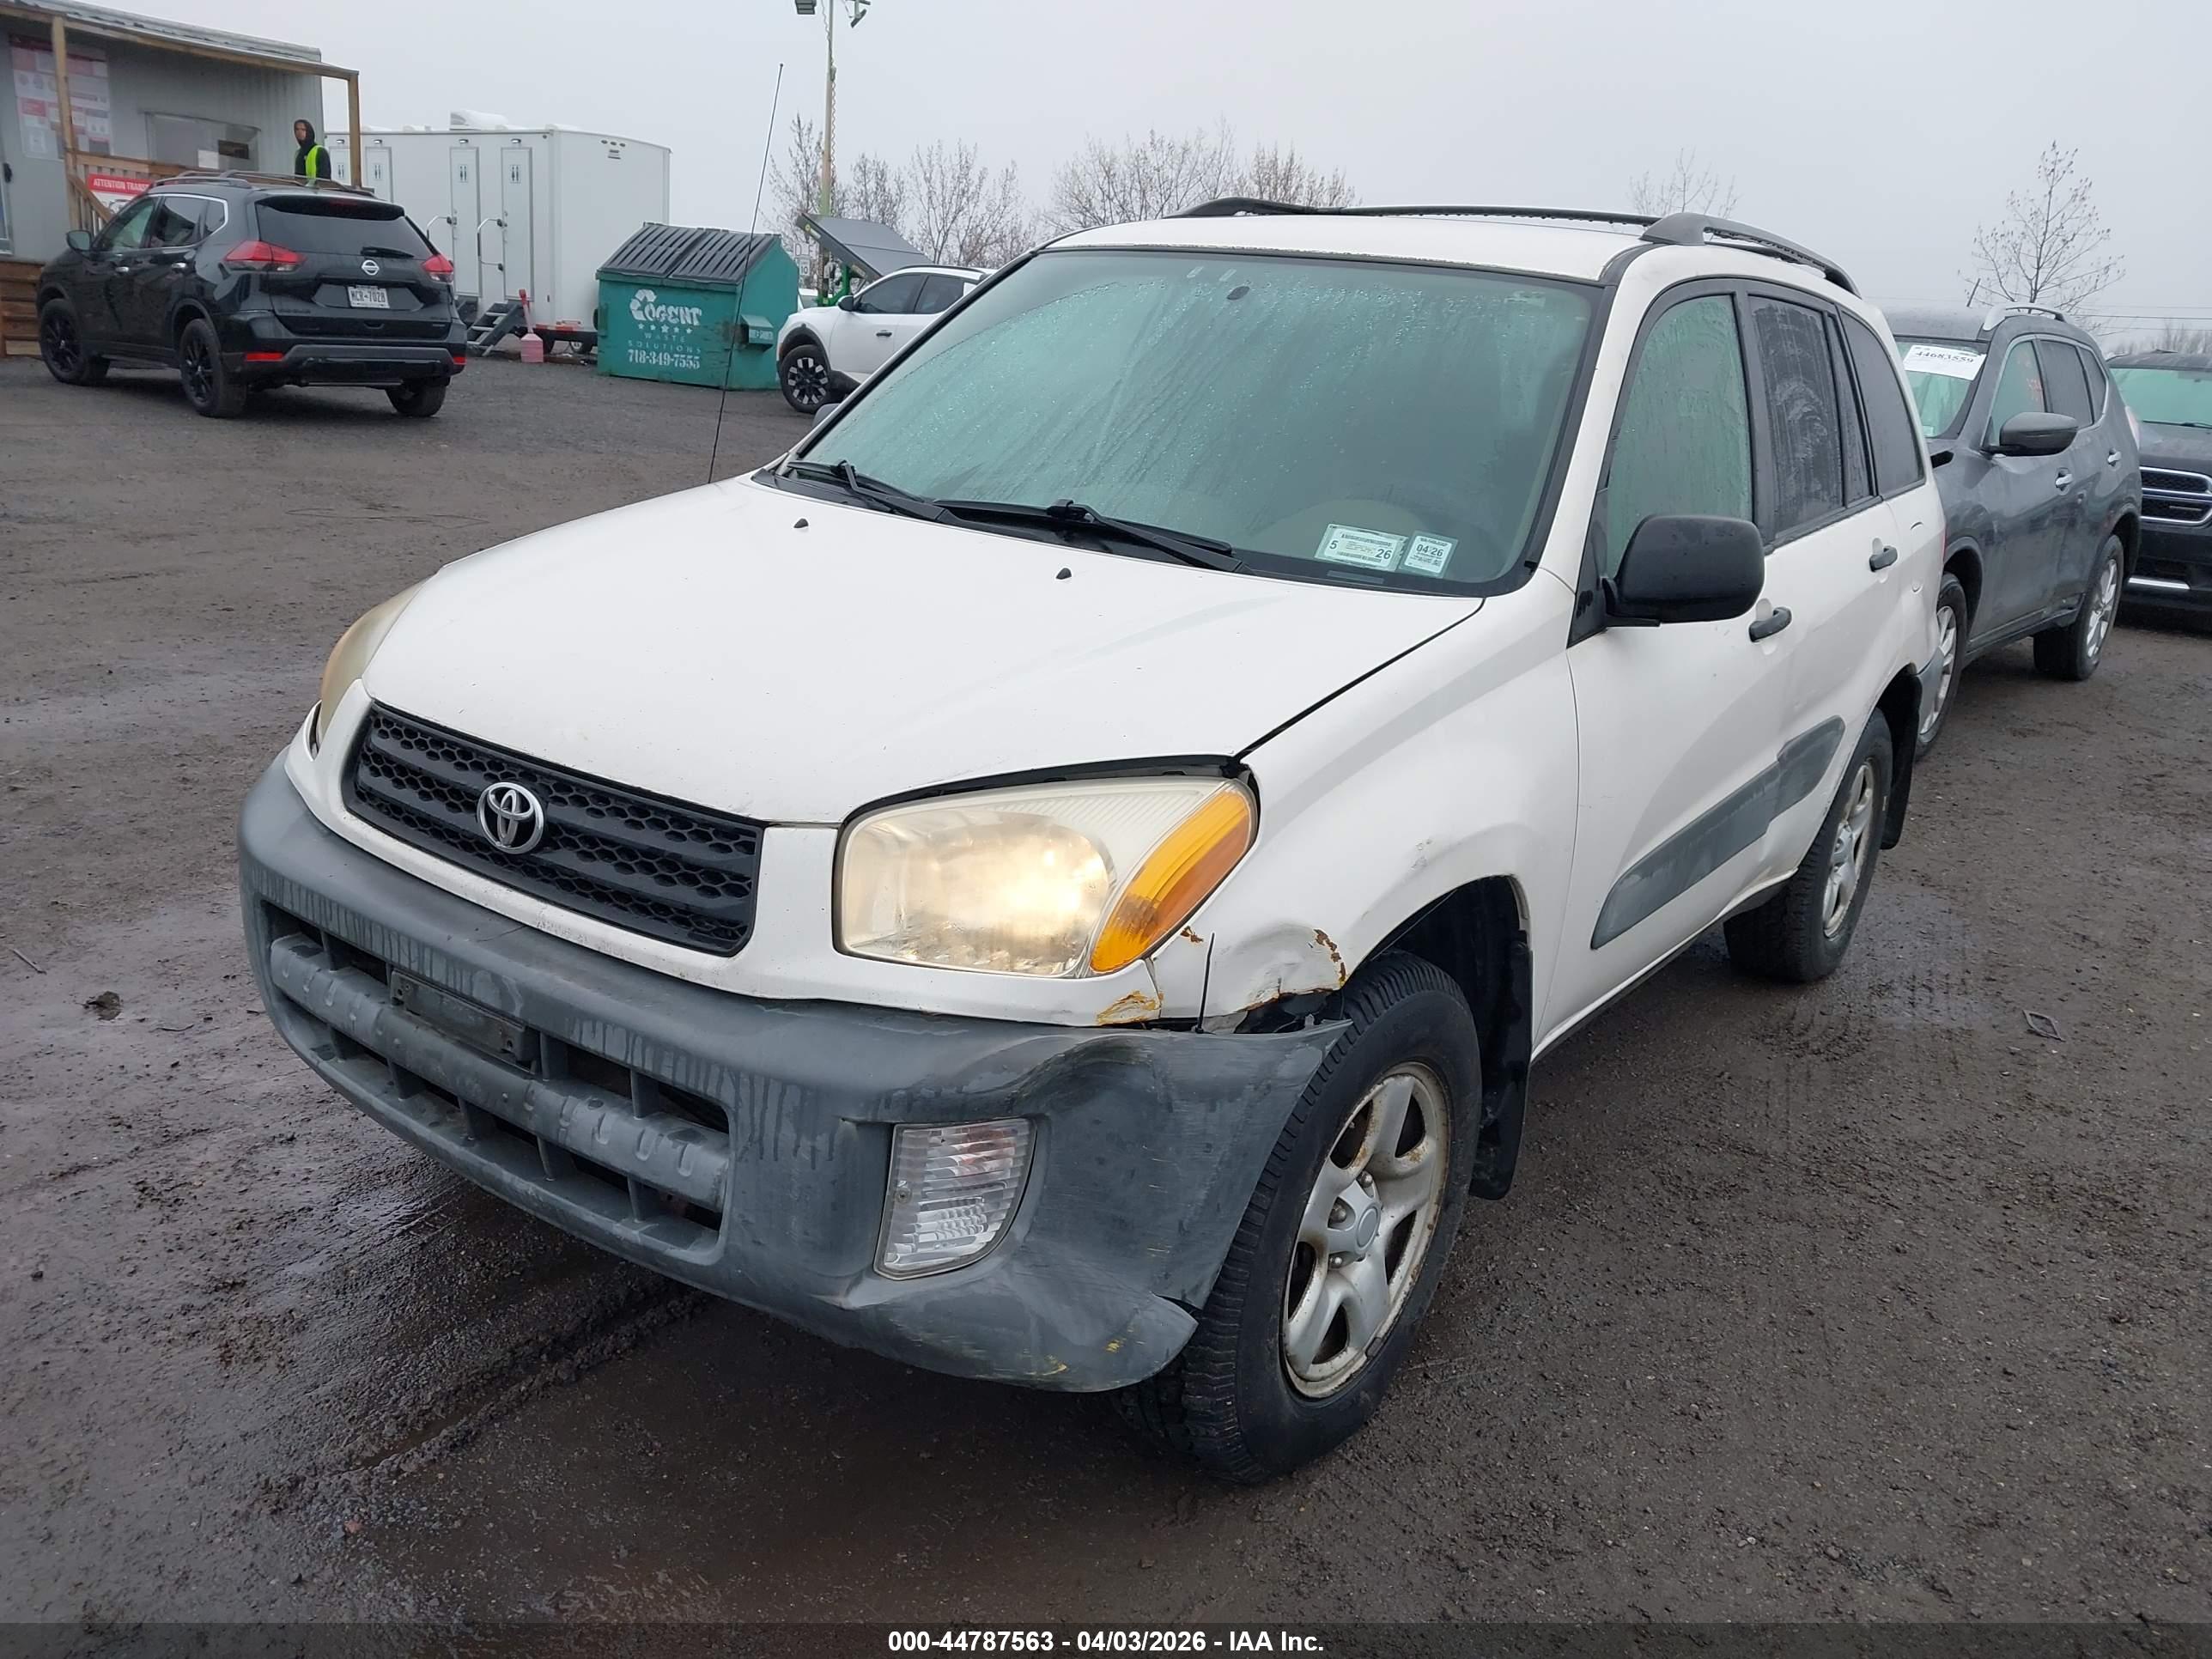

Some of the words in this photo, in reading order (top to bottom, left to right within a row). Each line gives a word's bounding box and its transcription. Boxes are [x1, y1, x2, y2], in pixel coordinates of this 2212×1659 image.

[93, 178, 125, 190] ATTENTION
[644, 332, 686, 343] WASTE
[628, 349, 701, 369] 718-349-7555
[1329, 540, 1339, 550] 5
[1375, 548, 1392, 560] 26
